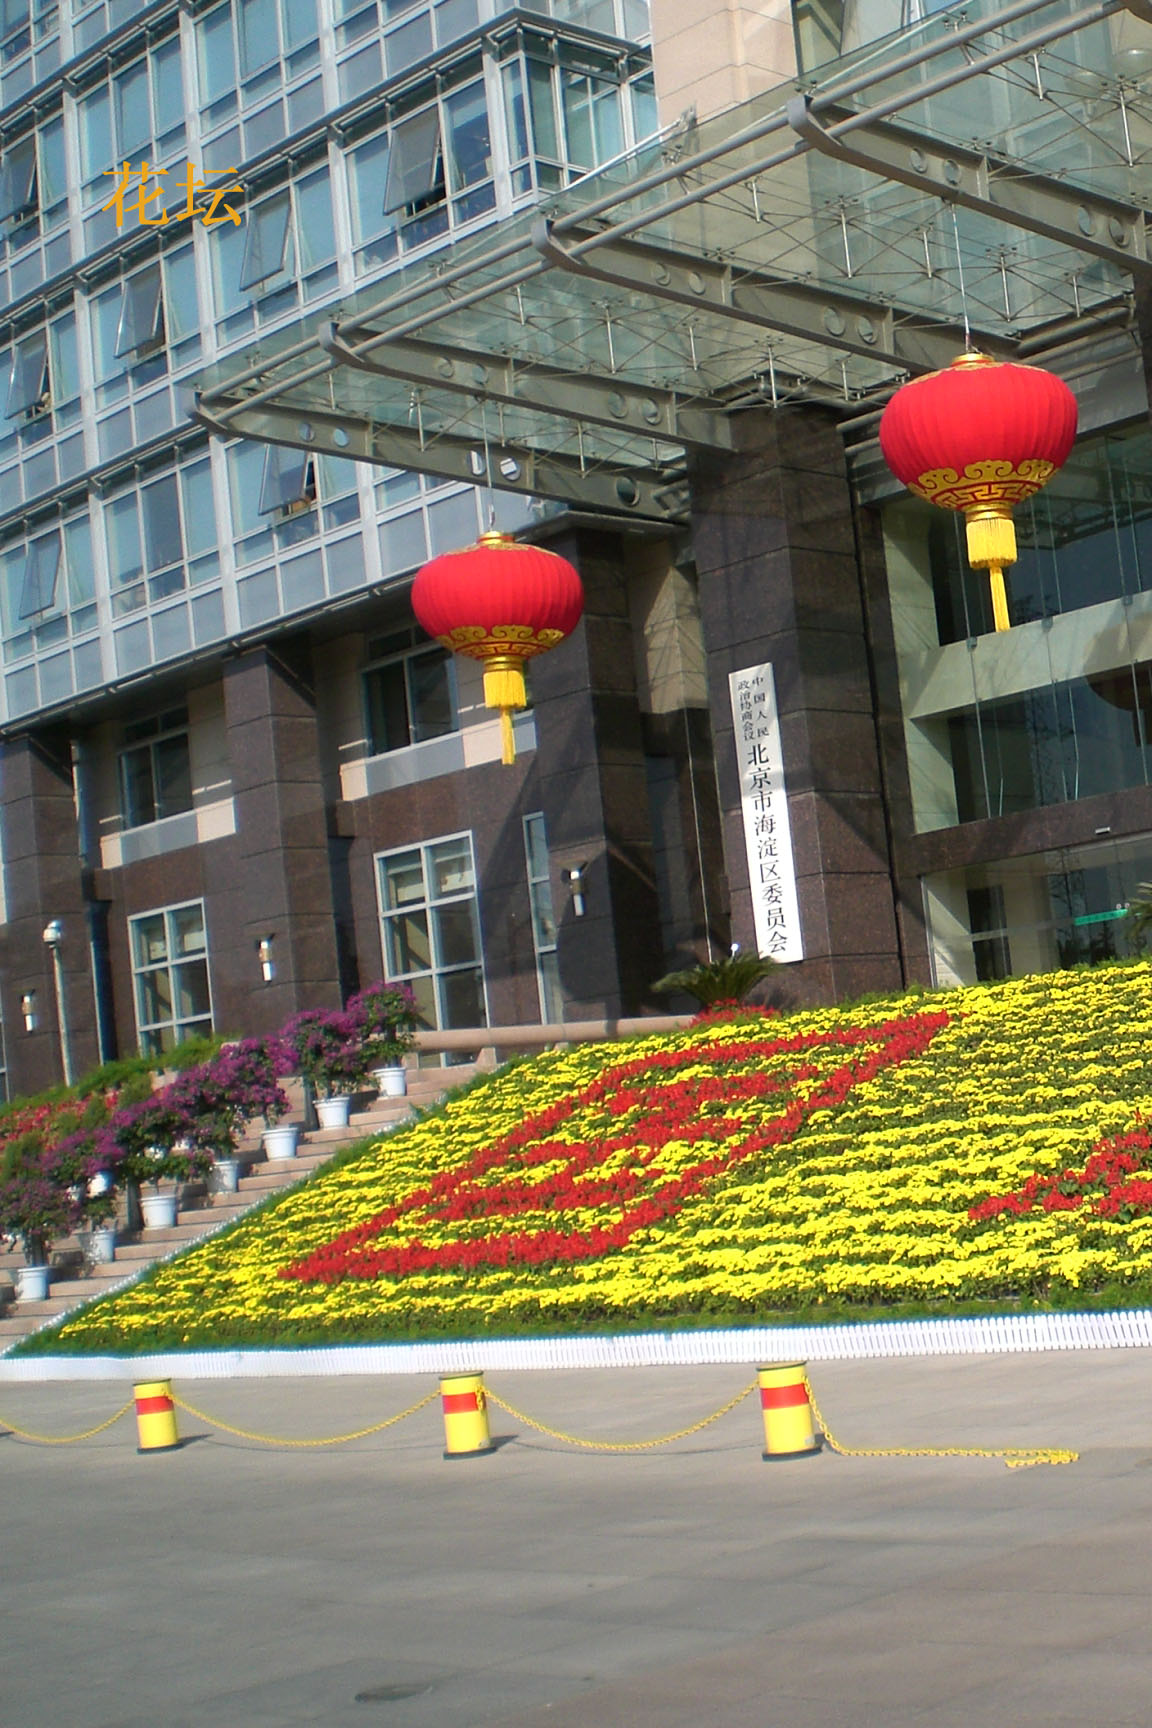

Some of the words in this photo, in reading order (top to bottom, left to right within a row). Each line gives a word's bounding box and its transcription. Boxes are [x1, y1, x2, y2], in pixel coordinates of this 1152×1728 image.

[751, 676, 770, 738] 中国人民
[747, 743, 789, 954] 北京市海淀区委员会
